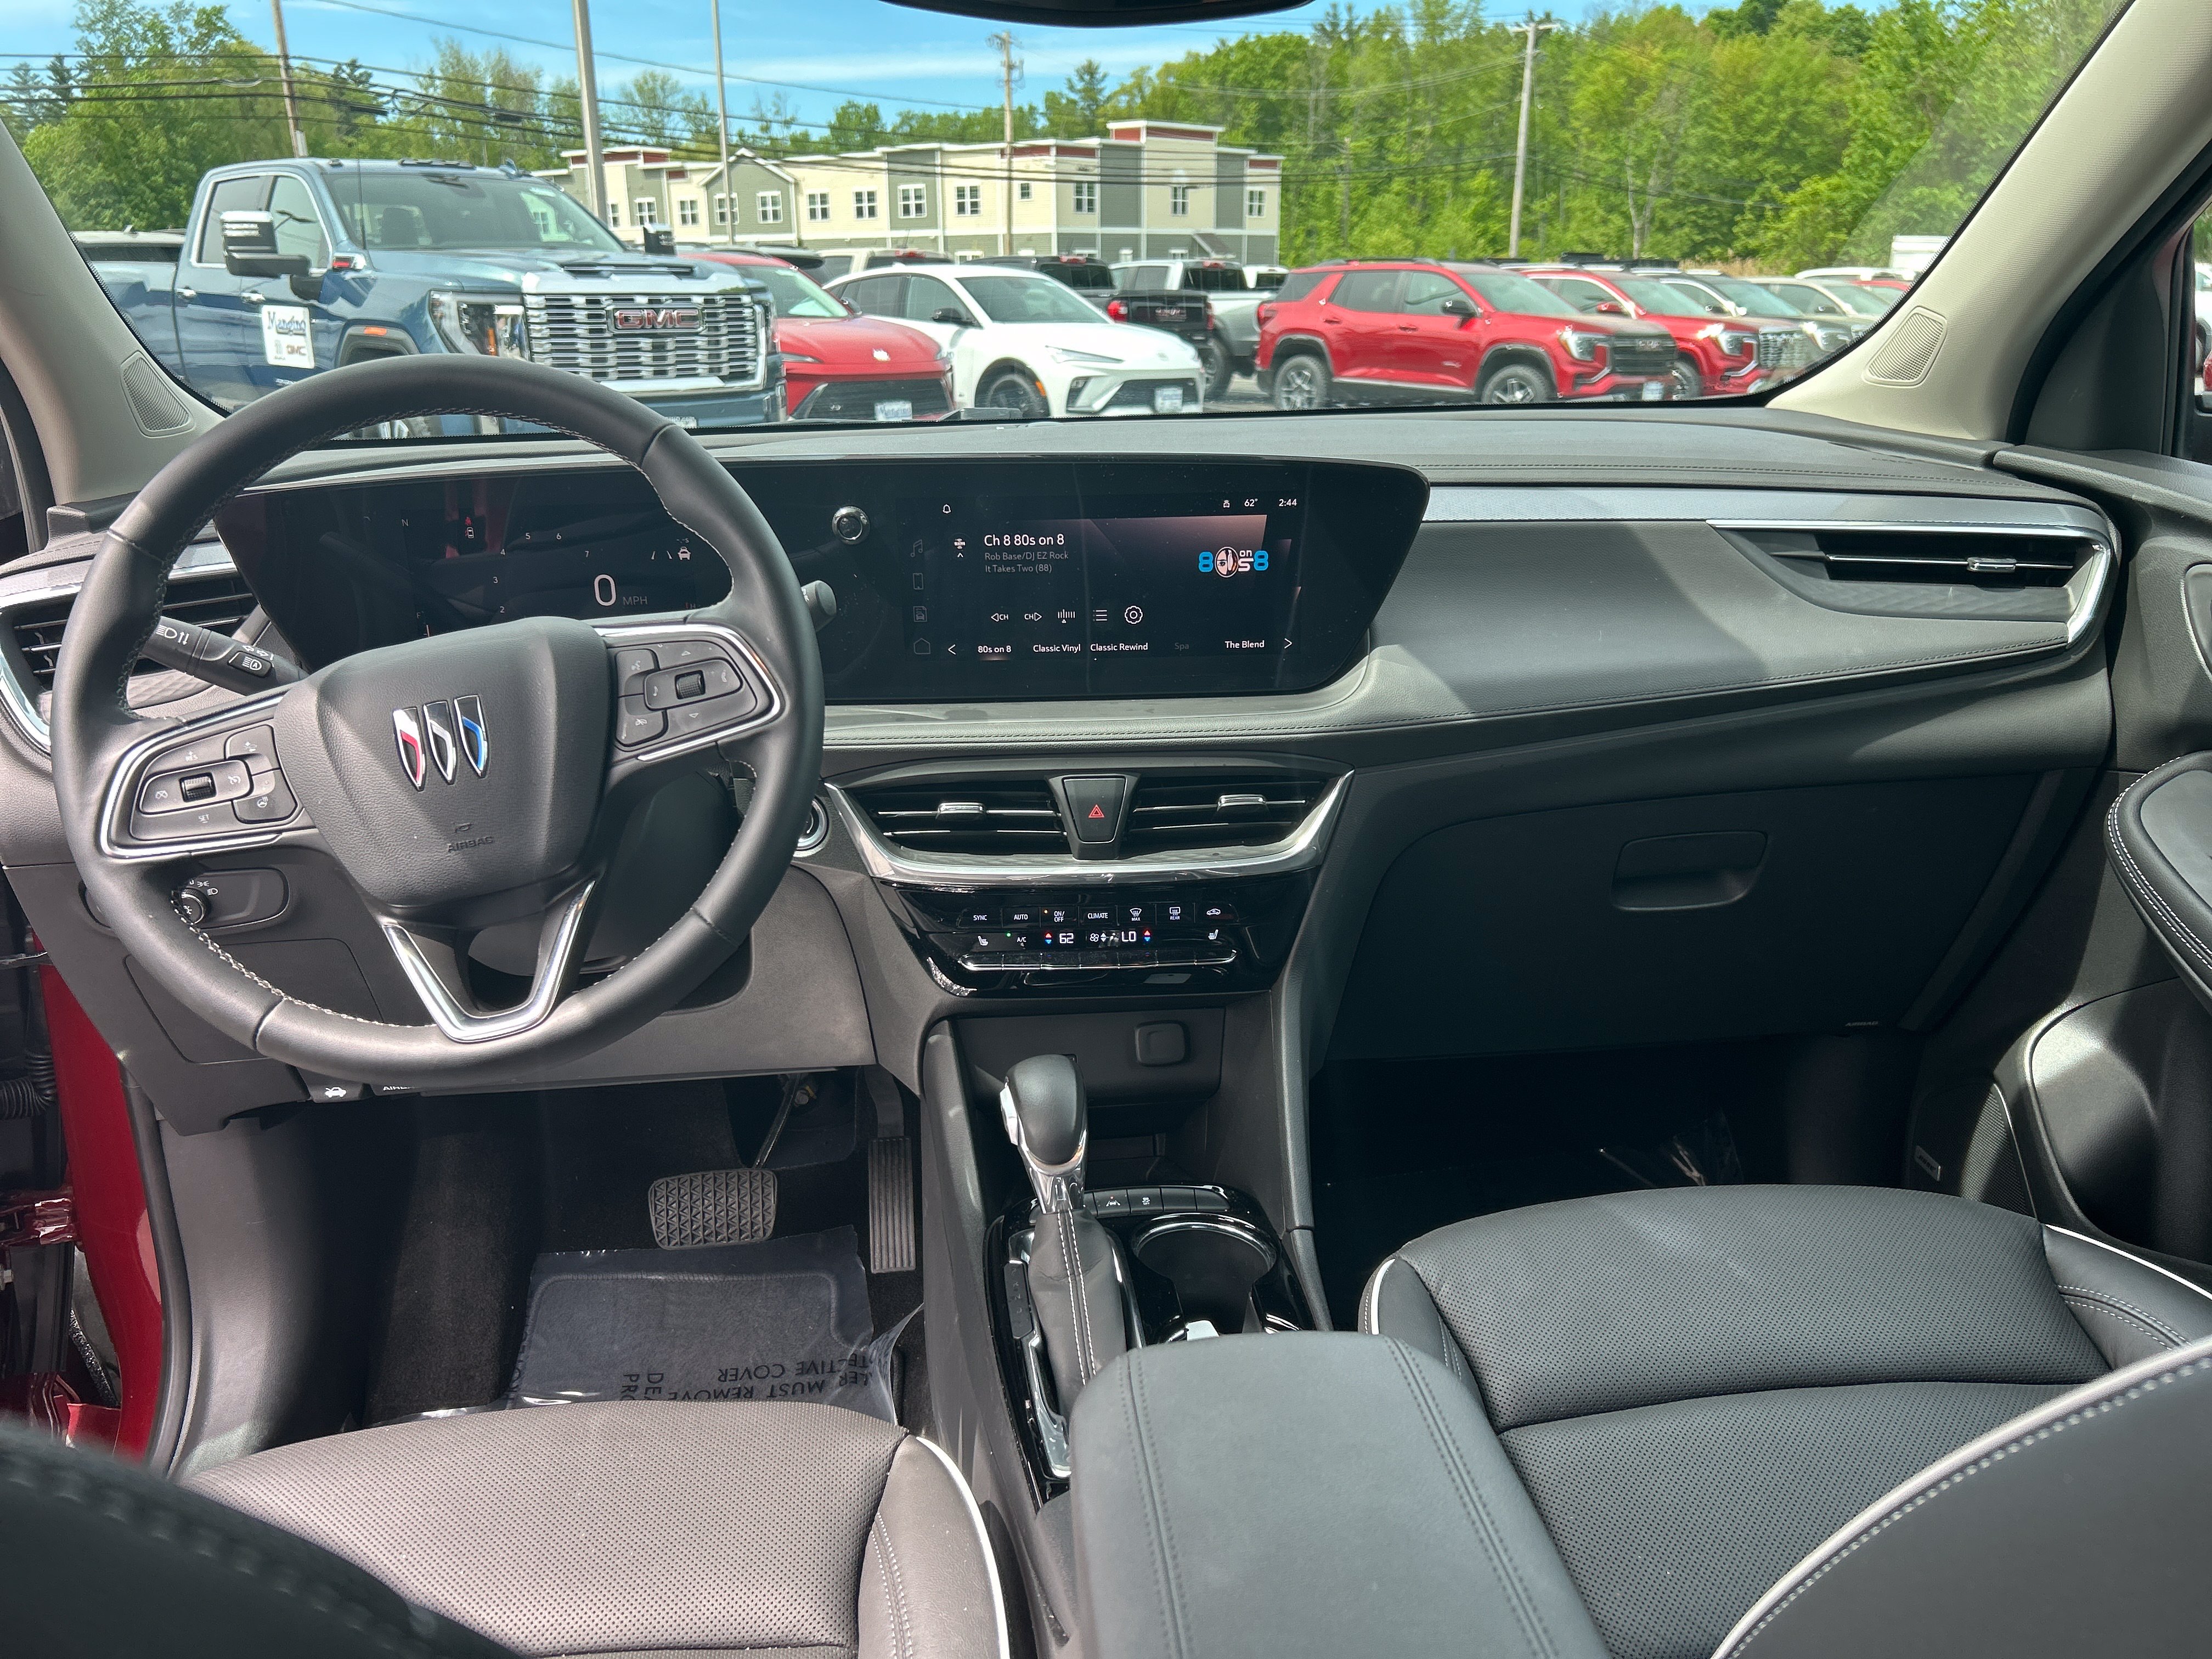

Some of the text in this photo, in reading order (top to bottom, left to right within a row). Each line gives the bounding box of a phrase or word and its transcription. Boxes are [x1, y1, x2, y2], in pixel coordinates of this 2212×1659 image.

[614, 309, 700, 329] GMC
[401, 518, 409, 527] N
[984, 534, 1064, 546] Ch 8 80s on 8
[985, 552, 1001, 560] Rob
[1002, 552, 1035, 561] Base/DJ
[1049, 550, 1069, 559] Rock
[1035, 563, 1052, 573] (88)
[594, 574, 617, 606] 0
[623, 596, 648, 605] MPH
[1032, 644, 1081, 653] Classic Vinyl
[1090, 644, 1119, 652] Classic
[1174, 642, 1189, 651] Spa
[447, 836, 493, 852] AIRBAG
[1059, 933, 1074, 944] 62
[1121, 931, 1137, 942] LO
[718, 1363, 786, 1383] COVER
[766, 1379, 826, 1398] MUST
